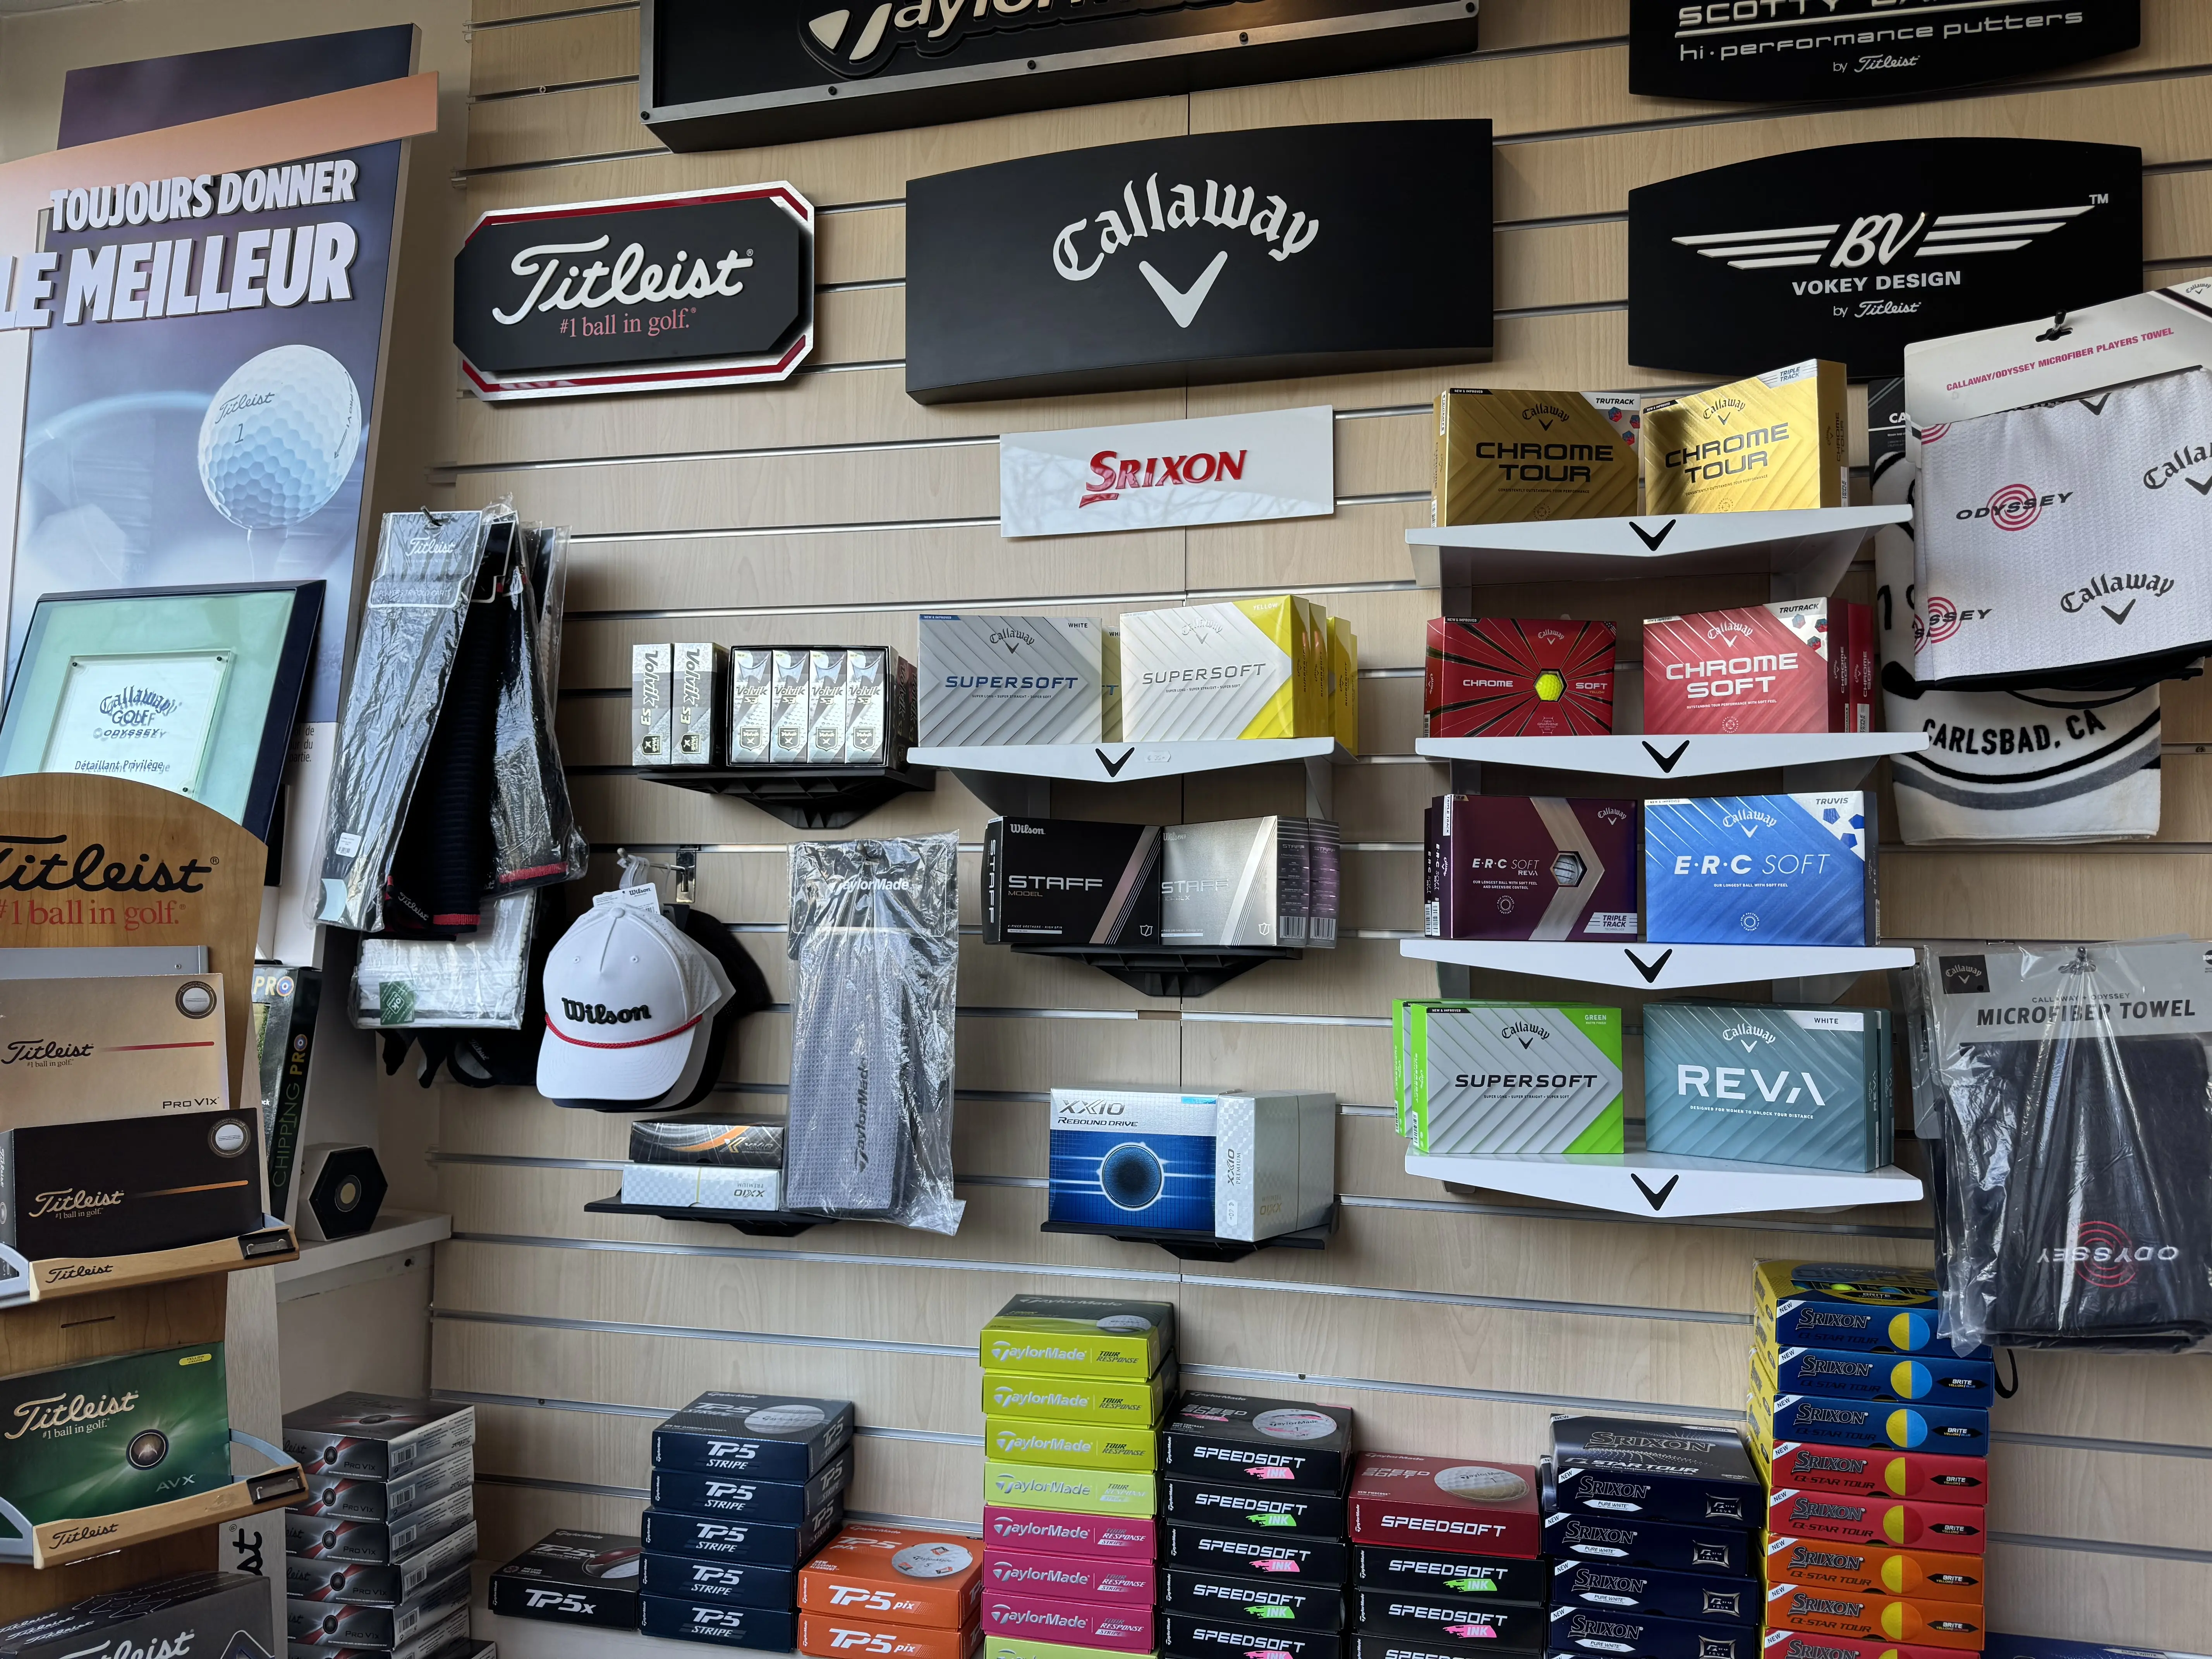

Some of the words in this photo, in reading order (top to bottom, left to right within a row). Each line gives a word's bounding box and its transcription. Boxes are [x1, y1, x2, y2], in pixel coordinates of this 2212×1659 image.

[1944, 12, 2083, 39] putters
[1833, 60, 1848, 72] by
[1854, 55, 1920, 72] Titleist
[50, 173, 214, 233] TOUJOURS
[217, 159, 359, 216] DONNER
[1053, 172, 1319, 281] Callaway
[62, 221, 359, 325] MEILLEUR
[492, 234, 753, 325] Titleist
[1792, 278, 1868, 296] VOKEY
[1875, 271, 1961, 290] DESIGN
[1833, 305, 1849, 318] by
[1854, 301, 1922, 318] Titleist
[560, 318, 577, 338] #1
[582, 314, 616, 336] ball
[623, 313, 642, 333] in
[648, 308, 690, 336] golf.
[1946, 362, 2035, 391] CALLAWAY/ODYSSEY
[2038, 347, 2094, 368] MICROFIBER
[2096, 335, 2139, 353] PLAYERS
[2141, 327, 2174, 342] TOWEL
[1780, 366, 1800, 377] TRIPLE
[1780, 372, 1800, 382] TRACK
[215, 392, 275, 425] Titleist
[1522, 403, 1570, 422] Callaway
[1703, 397, 1746, 420] Callaway
[235, 423, 244, 444] 1
[1475, 442, 1613, 462] CHROME
[1665, 422, 1789, 468] CHROME
[1499, 464, 1591, 483] TOUR
[1685, 450, 1768, 483] TOUR
[1079, 450, 1247, 509] SRIXON
[1955, 492, 2074, 520] ODYSSEY
[405, 537, 456, 556] Titleist
[2060, 573, 2175, 613] Callaway
[1779, 603, 1819, 614] TRUTRACK
[990, 628, 1035, 645] Callaway
[1538, 629, 1565, 640] Callaway
[1707, 621, 1753, 640] Callaway
[1142, 663, 1266, 685] SUPERSOFT
[1666, 653, 1798, 680] CHROME
[643, 650, 659, 707] Volvik
[683, 649, 700, 706] Volvik
[945, 676, 1078, 689] SUPERSOFT
[1463, 679, 1513, 687] CHROME
[1686, 676, 1776, 699] SOFT
[99, 684, 176, 716] Callaway
[736, 686, 768, 696] Volvik
[775, 686, 805, 696] Volvik
[112, 709, 149, 725] GOLF
[103, 729, 161, 737] ODYSSEY
[306, 725, 314, 735] de
[1923, 718, 2061, 755] CARLSBAD,
[2066, 710, 2107, 740] CA
[304, 739, 313, 749] du
[75, 760, 121, 771] Détaillant
[124, 759, 164, 773] Privilège
[1597, 807, 1626, 819] Callaway
[1723, 808, 1777, 828] Callaway
[1010, 824, 1044, 835] Wilson
[1511, 860, 1539, 869] SOFT
[1762, 854, 1830, 874] SOFT
[629, 886, 651, 896] Wilson
[1008, 875, 1103, 891] STAFF
[1162, 879, 1228, 894] STAFF
[29, 900, 82, 925] ball
[89, 899, 117, 924] in
[124, 900, 179, 931] golf.
[398, 893, 429, 922] Titleist
[1945, 964, 1982, 977] Callaway
[562, 997, 652, 1025] Wilson
[1977, 1004, 2111, 1026] MICROFIBER
[2120, 999, 2196, 1019] TOWEL
[1501, 1021, 1550, 1040] Callaway
[1723, 1023, 1776, 1044] Callaway
[0, 1038, 94, 1065] Titleist
[1455, 1074, 1597, 1088] SUPERSOFT
[1678, 1064, 1825, 1106] REVA
[273, 1083, 300, 1187] CHIPPING
[28, 1188, 125, 1218] Titleist
[2037, 1247, 2179, 1264] ODYSSEY
[45, 1264, 113, 1284] Titleist
[1779, 1302, 1793, 1313] NEW
[1796, 1307, 1871, 1330] SRIXON
[991, 1341, 1087, 1361] TaylorMade
[4, 1391, 139, 1440] Titleist
[42, 1430, 52, 1440] #1
[53, 1426, 72, 1438] ball
[86, 1419, 108, 1435] golf.
[706, 1441, 760, 1460] TP5
[1583, 1432, 1716, 1453] SRIXON
[706, 1458, 749, 1470] STRIPE
[1194, 1446, 1306, 1468] SPEEDSOFT
[1791, 1451, 1868, 1473] SRIXON
[155, 1474, 196, 1493] AVX
[1267, 1469, 1286, 1478] INK
[1843, 1479, 1875, 1489] TOUR
[1575, 1476, 1651, 1499] SRIXON
[49, 1523, 119, 1549] Titleist
[993, 1516, 1090, 1539] TaylorMade
[1381, 1515, 1506, 1537] SPEEDSOFT
[1102, 1533, 1146, 1541] RESPONSE
[525, 1589, 597, 1615] TP5x
[828, 1585, 896, 1611] TP5
[893, 1601, 915, 1610] pix
